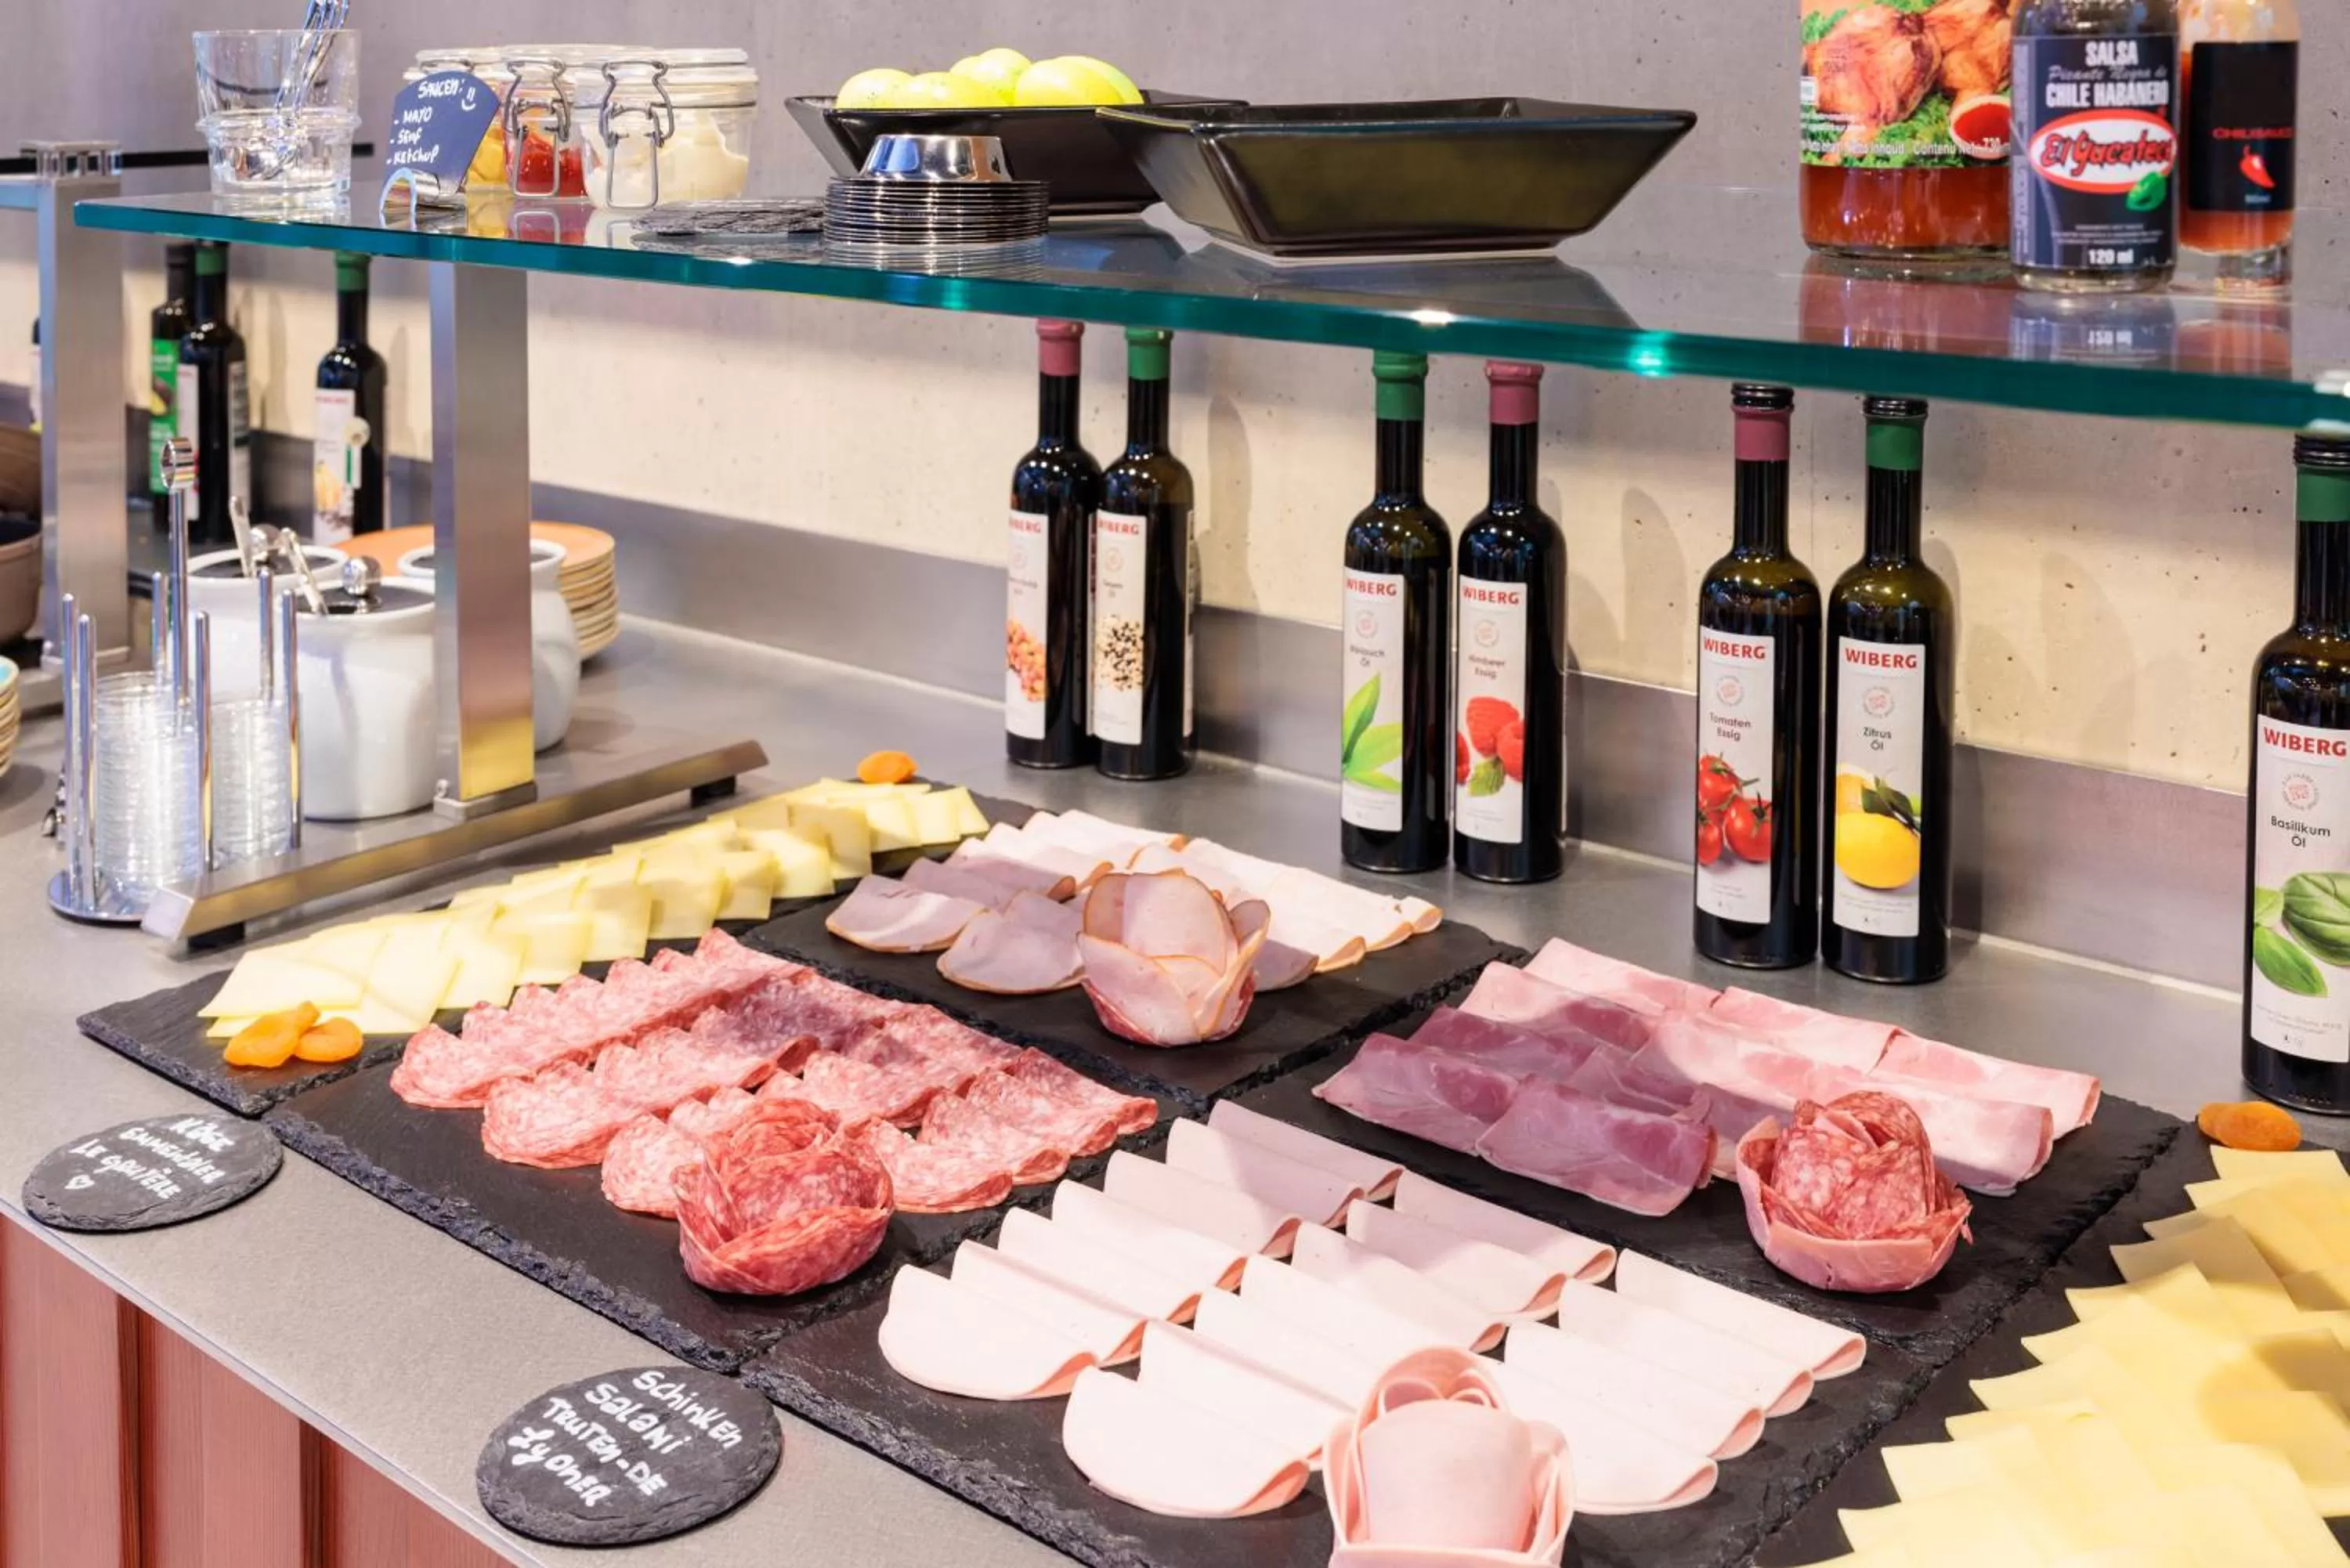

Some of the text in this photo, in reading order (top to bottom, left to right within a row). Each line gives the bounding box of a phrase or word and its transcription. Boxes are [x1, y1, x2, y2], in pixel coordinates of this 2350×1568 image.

[2085, 40, 2139, 66] SALSA
[2046, 81, 2091, 107] CHILE
[403, 107, 432, 124] MAYO
[2088, 248, 2115, 265] 120
[1346, 578, 1397, 597] WIBERG
[1462, 585, 1520, 605] WIBERG
[1703, 636, 1766, 660] WIBERG
[1845, 648, 1918, 669] WIBERG
[1709, 711, 1752, 728] Tomaten
[1716, 727, 1741, 742] Essig
[1863, 726, 1892, 739] Zitrus
[2263, 726, 2348, 757] WIBERG
[2271, 815, 2331, 838] Basilikum
[2291, 834, 2307, 849] Öl
